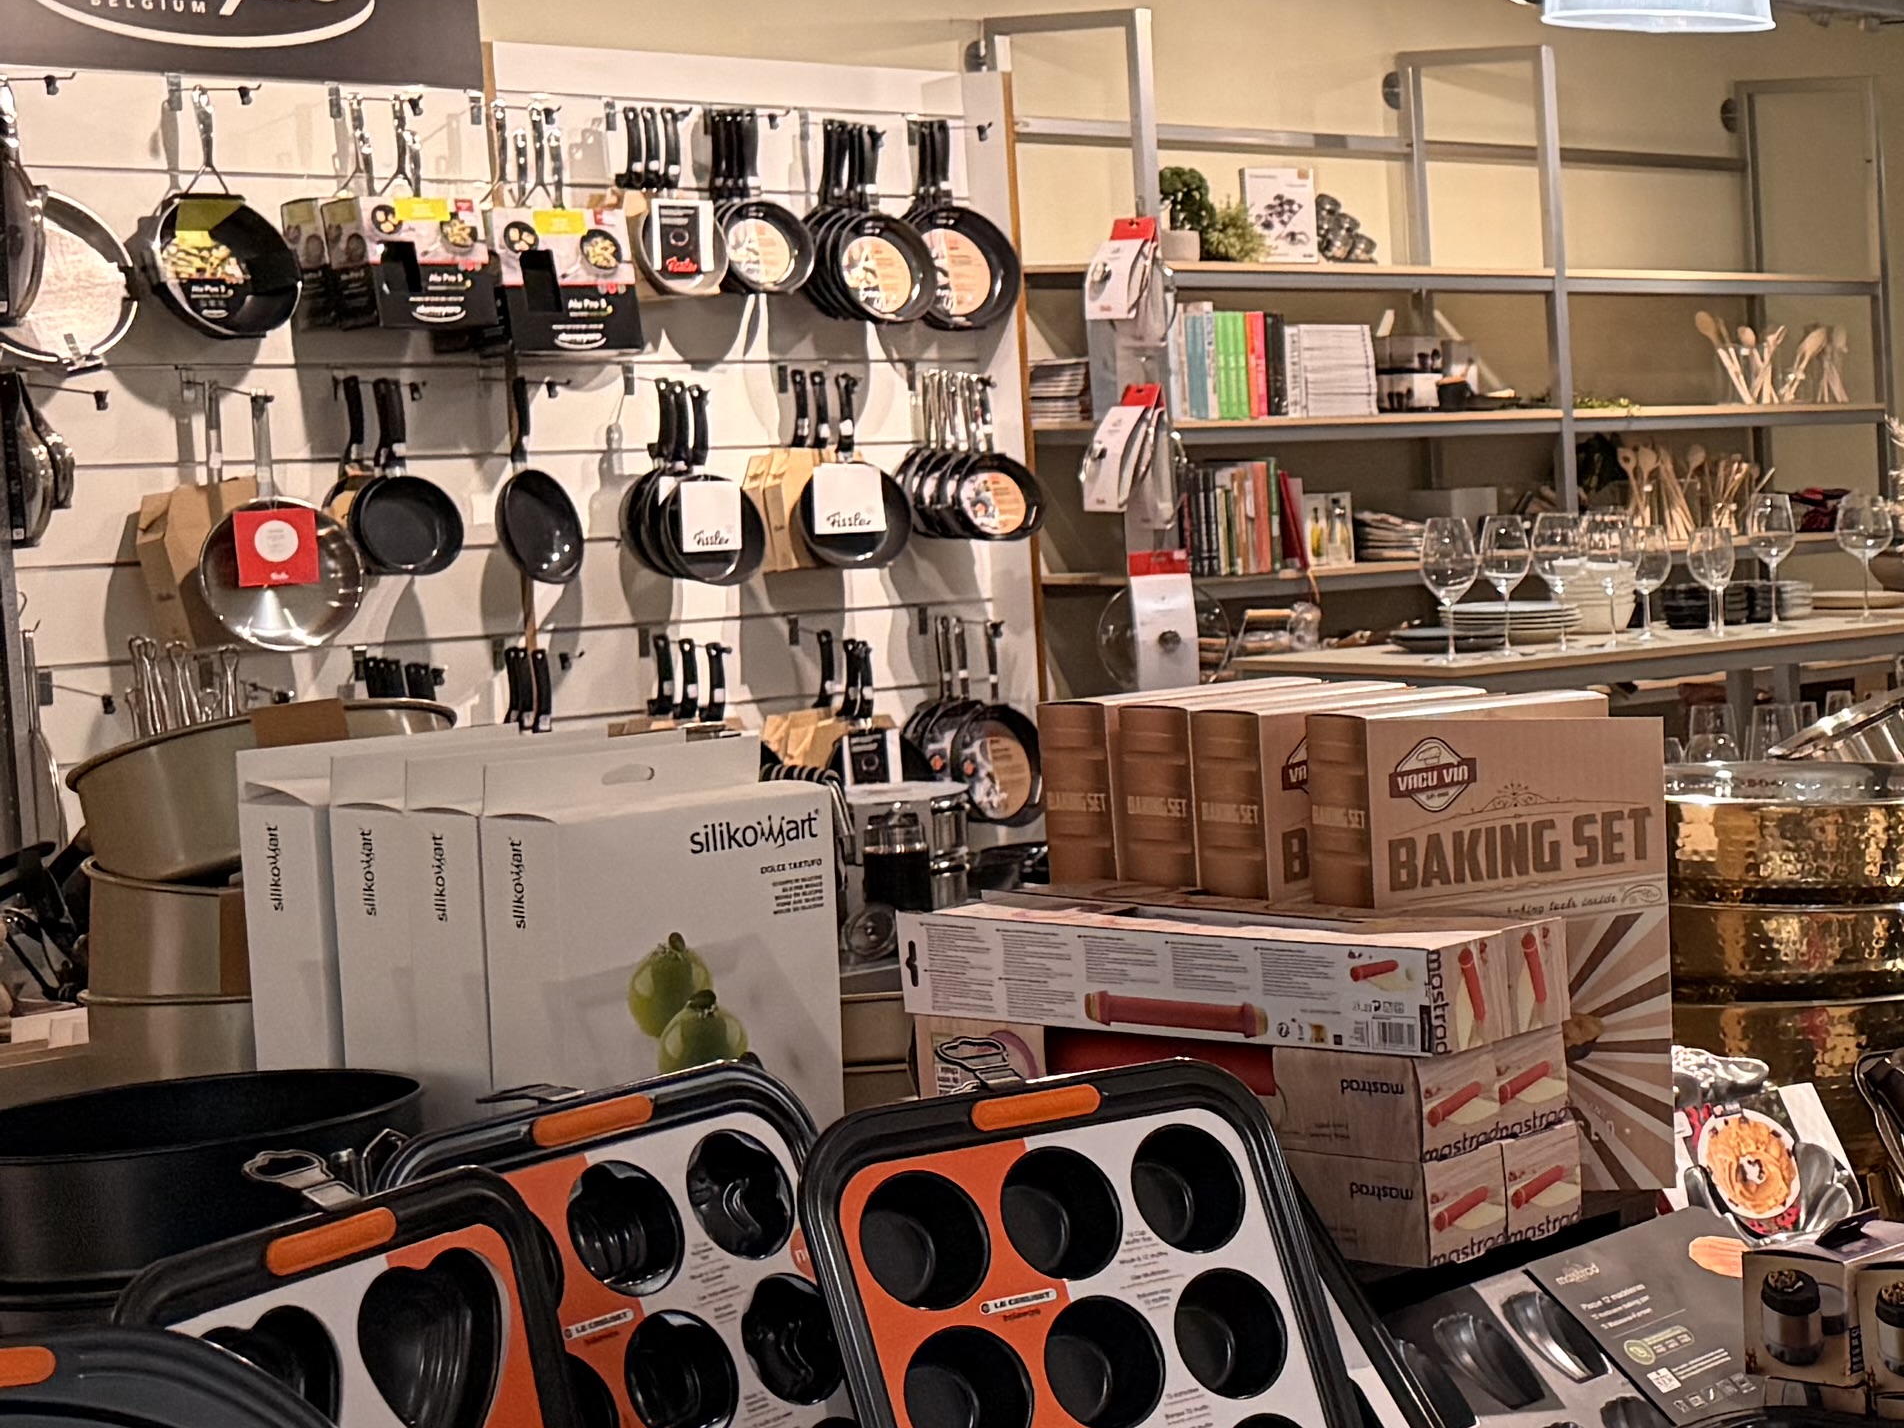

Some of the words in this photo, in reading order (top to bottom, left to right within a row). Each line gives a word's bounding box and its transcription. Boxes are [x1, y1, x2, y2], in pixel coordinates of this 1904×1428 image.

[1388, 819, 1562, 892] BAKING
[1572, 807, 1653, 868] SET
[1427, 949, 1452, 1057] mastrad
[1341, 1078, 1405, 1095] mastrad
[1350, 1181, 1413, 1201] mastrad
